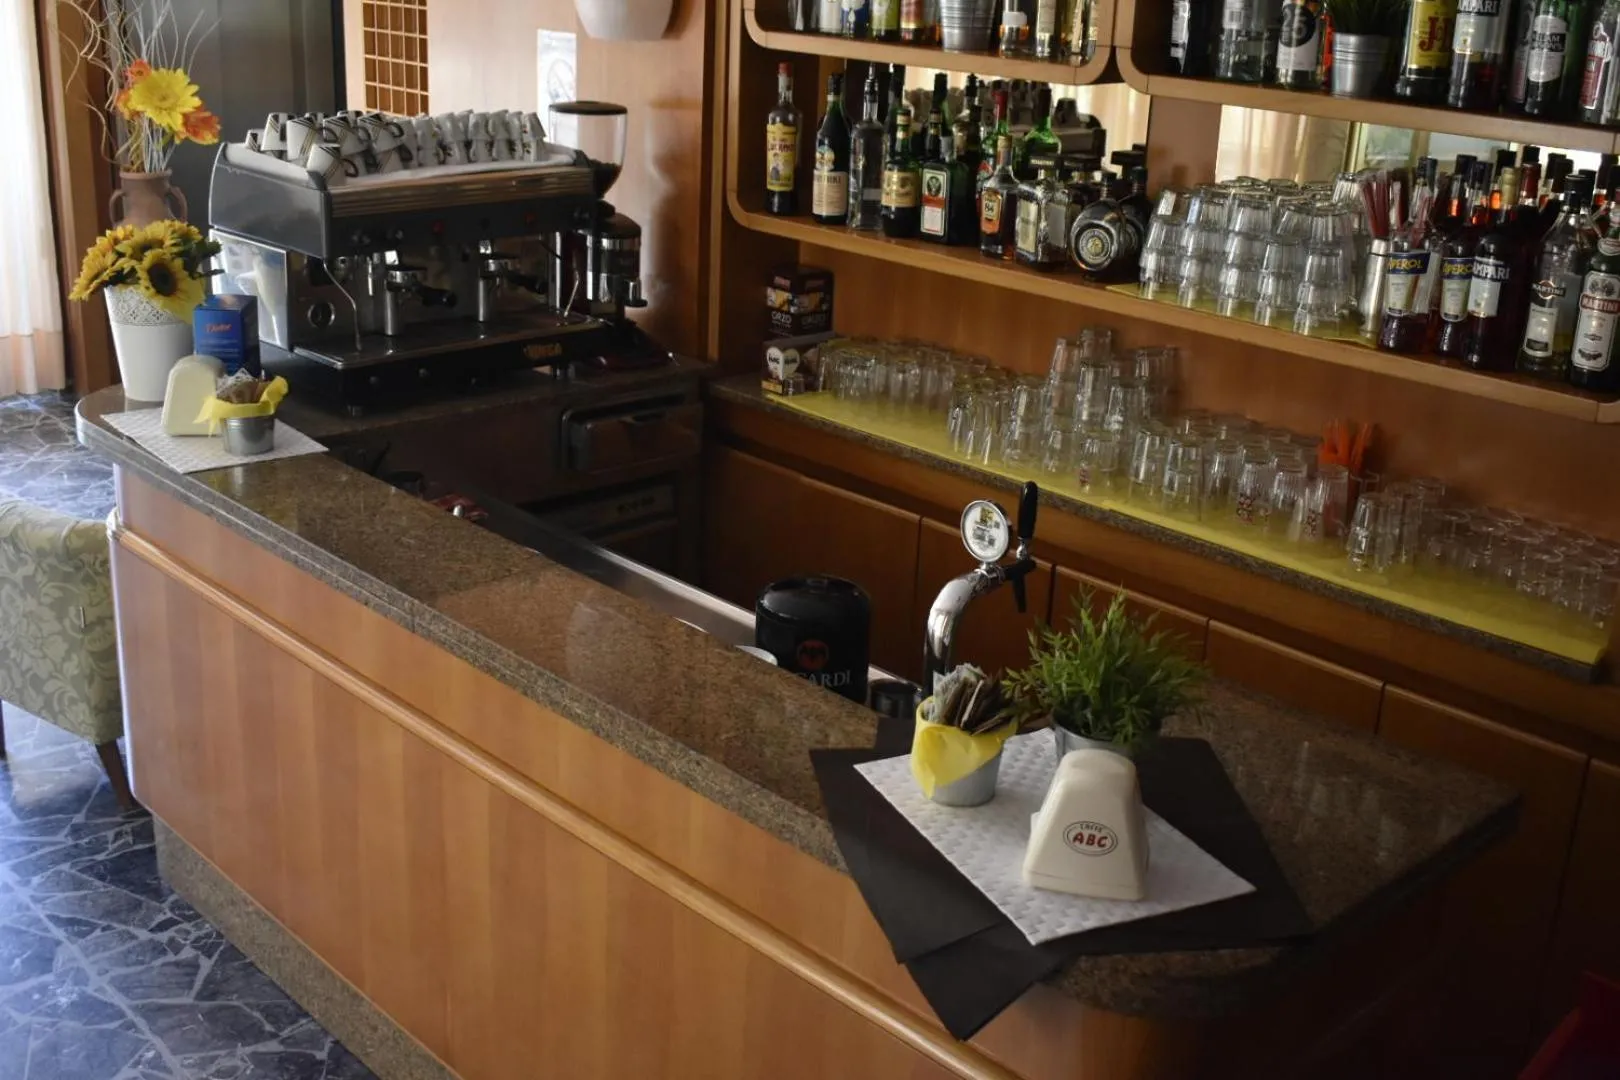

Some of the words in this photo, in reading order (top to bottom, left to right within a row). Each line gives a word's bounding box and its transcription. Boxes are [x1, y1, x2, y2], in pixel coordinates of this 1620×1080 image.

[1443, 262, 1472, 273] APERO
[1473, 260, 1510, 279] AMPARI
[1073, 832, 1108, 848] ABC
